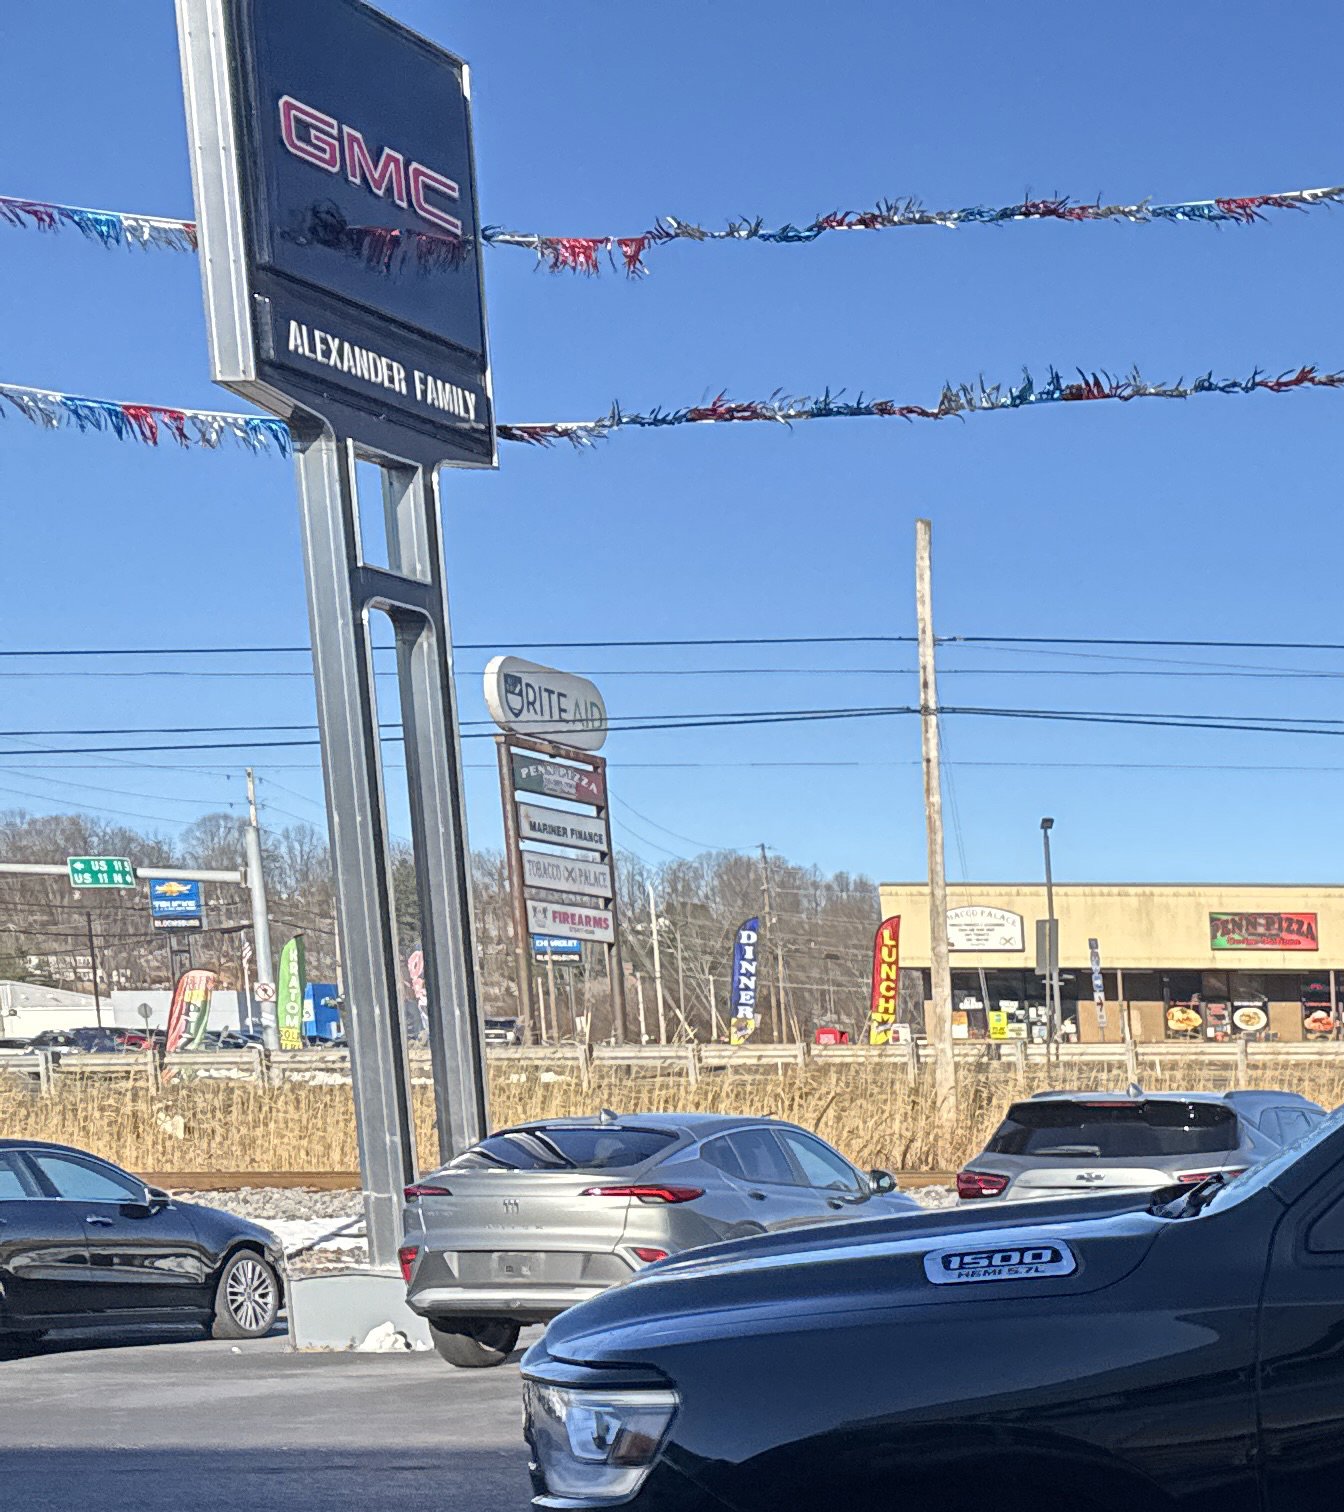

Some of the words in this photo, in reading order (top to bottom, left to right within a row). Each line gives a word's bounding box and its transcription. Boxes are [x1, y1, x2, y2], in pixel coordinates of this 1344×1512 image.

[278, 94, 462, 236] GMC
[288, 320, 407, 395] ALEXANDER
[413, 370, 476, 420] FAMILY
[525, 682, 568, 720] RITE
[573, 699, 602, 728] AID
[520, 764, 554, 779] PENN
[559, 767, 598, 794] PIZZA
[529, 820, 568, 838] MARINER
[570, 827, 604, 845] FINANCE
[74, 873, 92, 884] US
[90, 860, 107, 871] US
[527, 859, 562, 881] TOBACCO
[578, 868, 608, 888] PALACE
[551, 910, 610, 930] FIREARMS
[737, 930, 758, 1019] DINNER
[878, 928, 897, 1013] LUNCH
[285, 949, 300, 1028] KRATOM
[949, 1248, 1053, 1269] 1500
[957, 1267, 1003, 1278] HEMI
[1007, 1265, 1046, 1275] 5.7L
